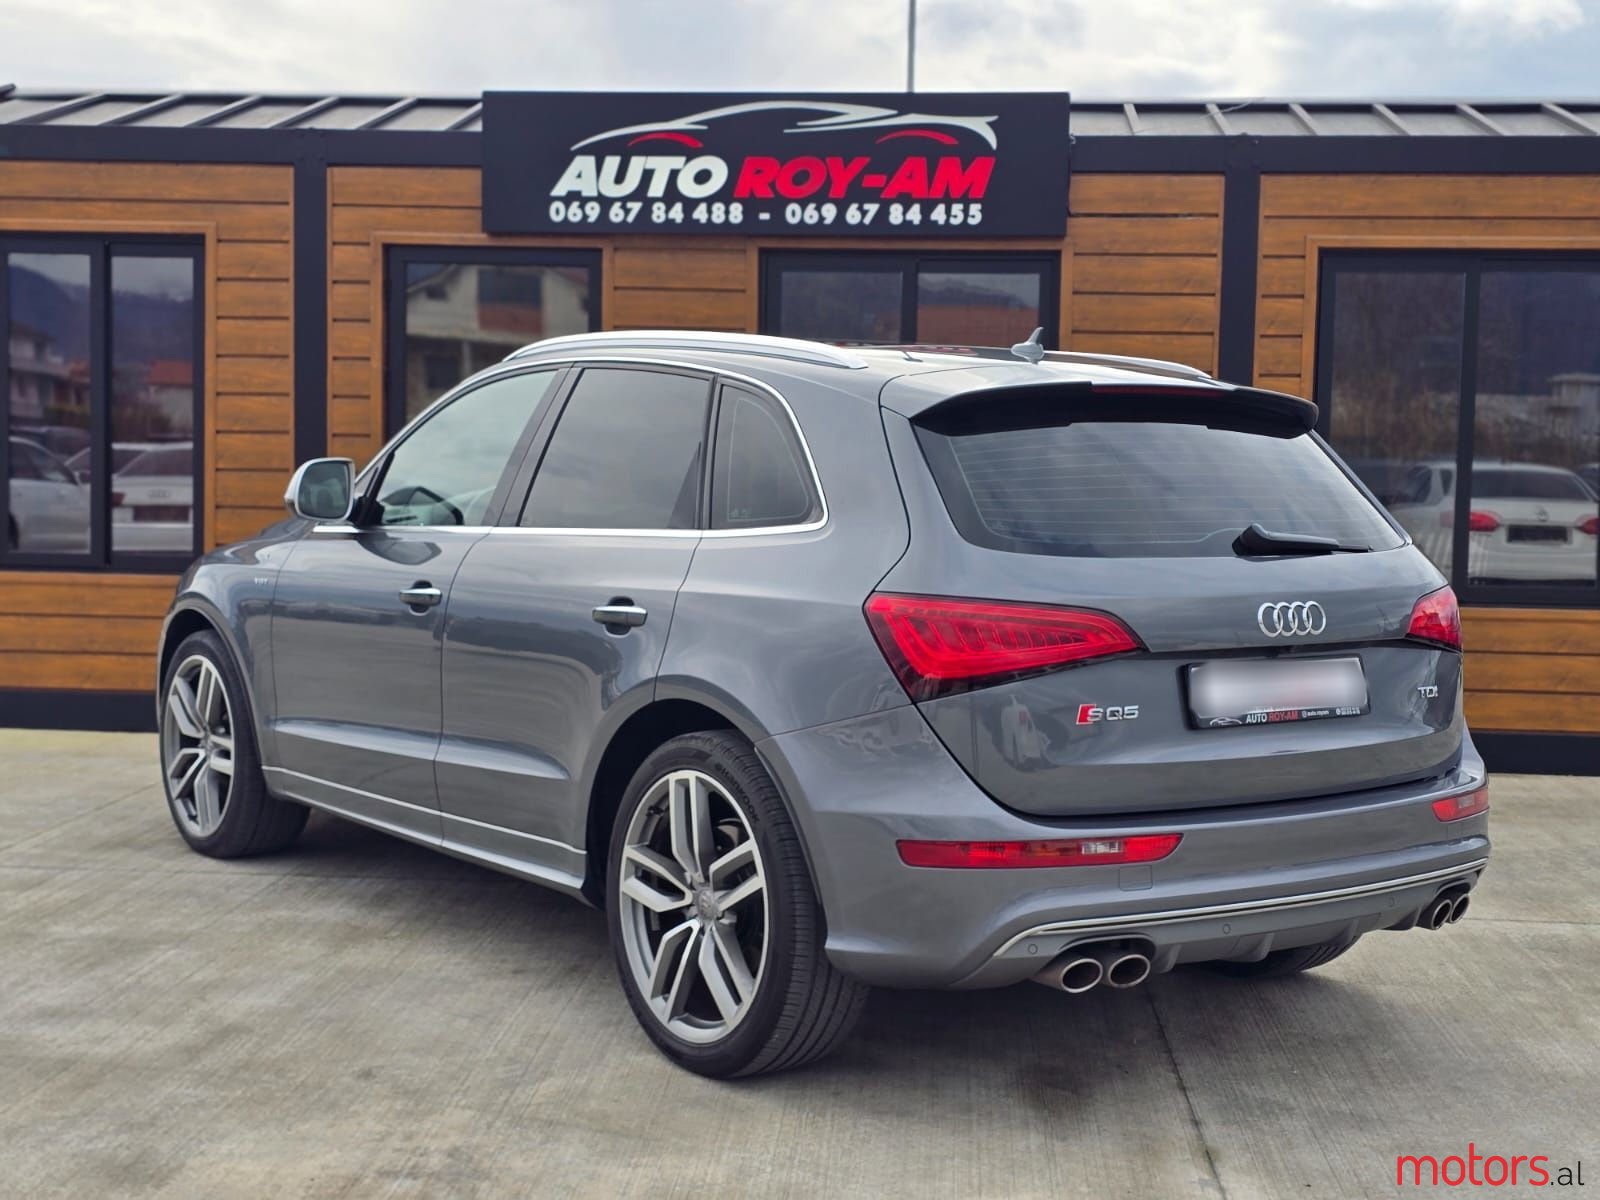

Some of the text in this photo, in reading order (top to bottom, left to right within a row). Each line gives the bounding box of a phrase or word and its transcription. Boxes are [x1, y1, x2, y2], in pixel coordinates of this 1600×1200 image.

[550, 155, 996, 199] AUTO ROY-AM
[549, 201, 983, 226] 069 67 84 488 - 069 67 84 455
[1085, 704, 1139, 722] SQ5
[1246, 710, 1298, 724] AUTO ROY-AM
